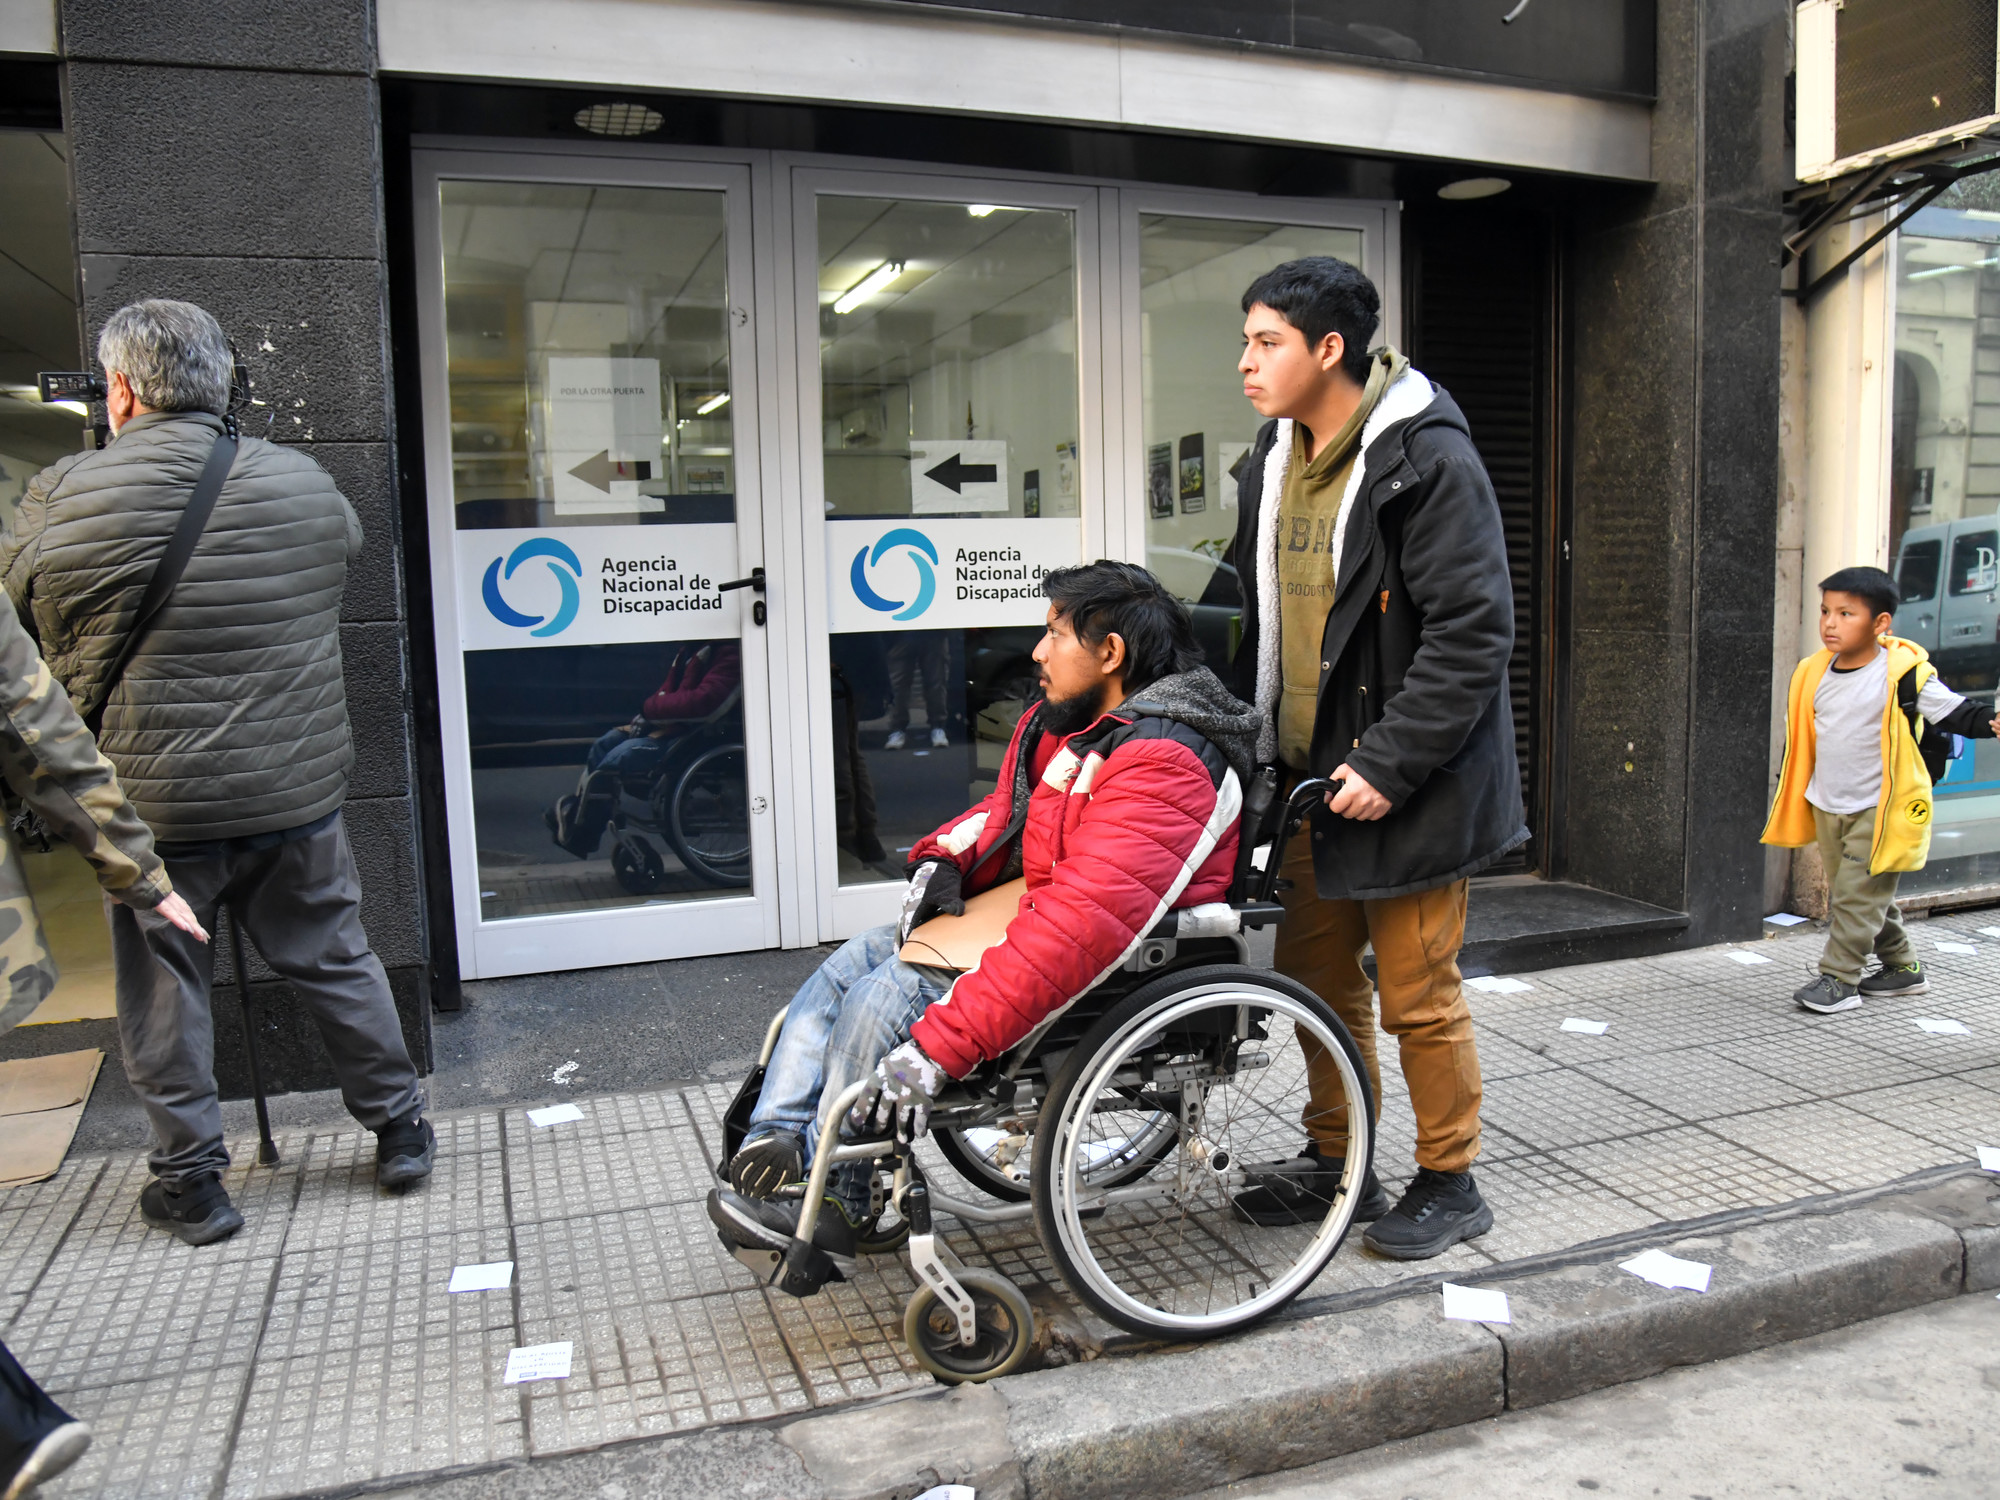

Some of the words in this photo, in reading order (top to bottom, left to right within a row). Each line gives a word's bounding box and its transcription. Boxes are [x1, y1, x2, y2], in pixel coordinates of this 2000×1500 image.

[560, 387, 577, 395] POR
[578, 387, 589, 395] LA
[590, 387, 612, 395] OTRA
[613, 387, 645, 395] PUERTA
[601, 555, 677, 576] Agencia
[955, 546, 1022, 566] Agencia
[956, 564, 1027, 581] Nacional
[1032, 564, 1050, 580] de
[602, 574, 684, 593] Nacional
[689, 573, 711, 590] de
[603, 593, 723, 615] Discapacidad
